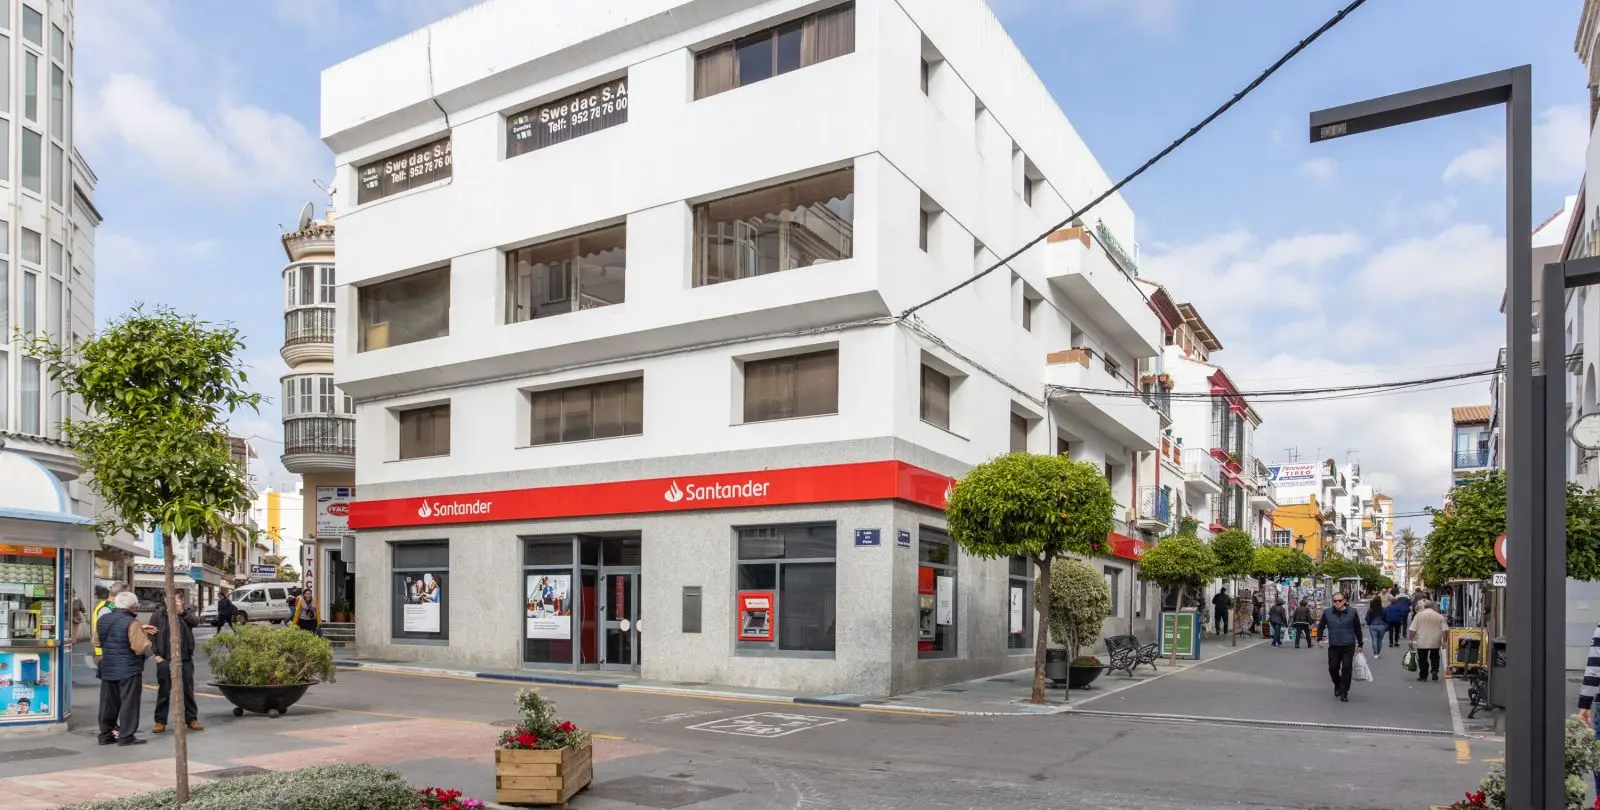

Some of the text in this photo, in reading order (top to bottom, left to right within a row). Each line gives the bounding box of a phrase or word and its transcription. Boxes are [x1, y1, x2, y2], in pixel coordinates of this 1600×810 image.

[602, 86, 614, 102] S.
[548, 97, 627, 134] Telf: 952 78 76 00
[409, 164, 423, 178] 952
[434, 157, 443, 169] 76
[686, 480, 770, 501] Santander
[433, 499, 492, 516] Santander
